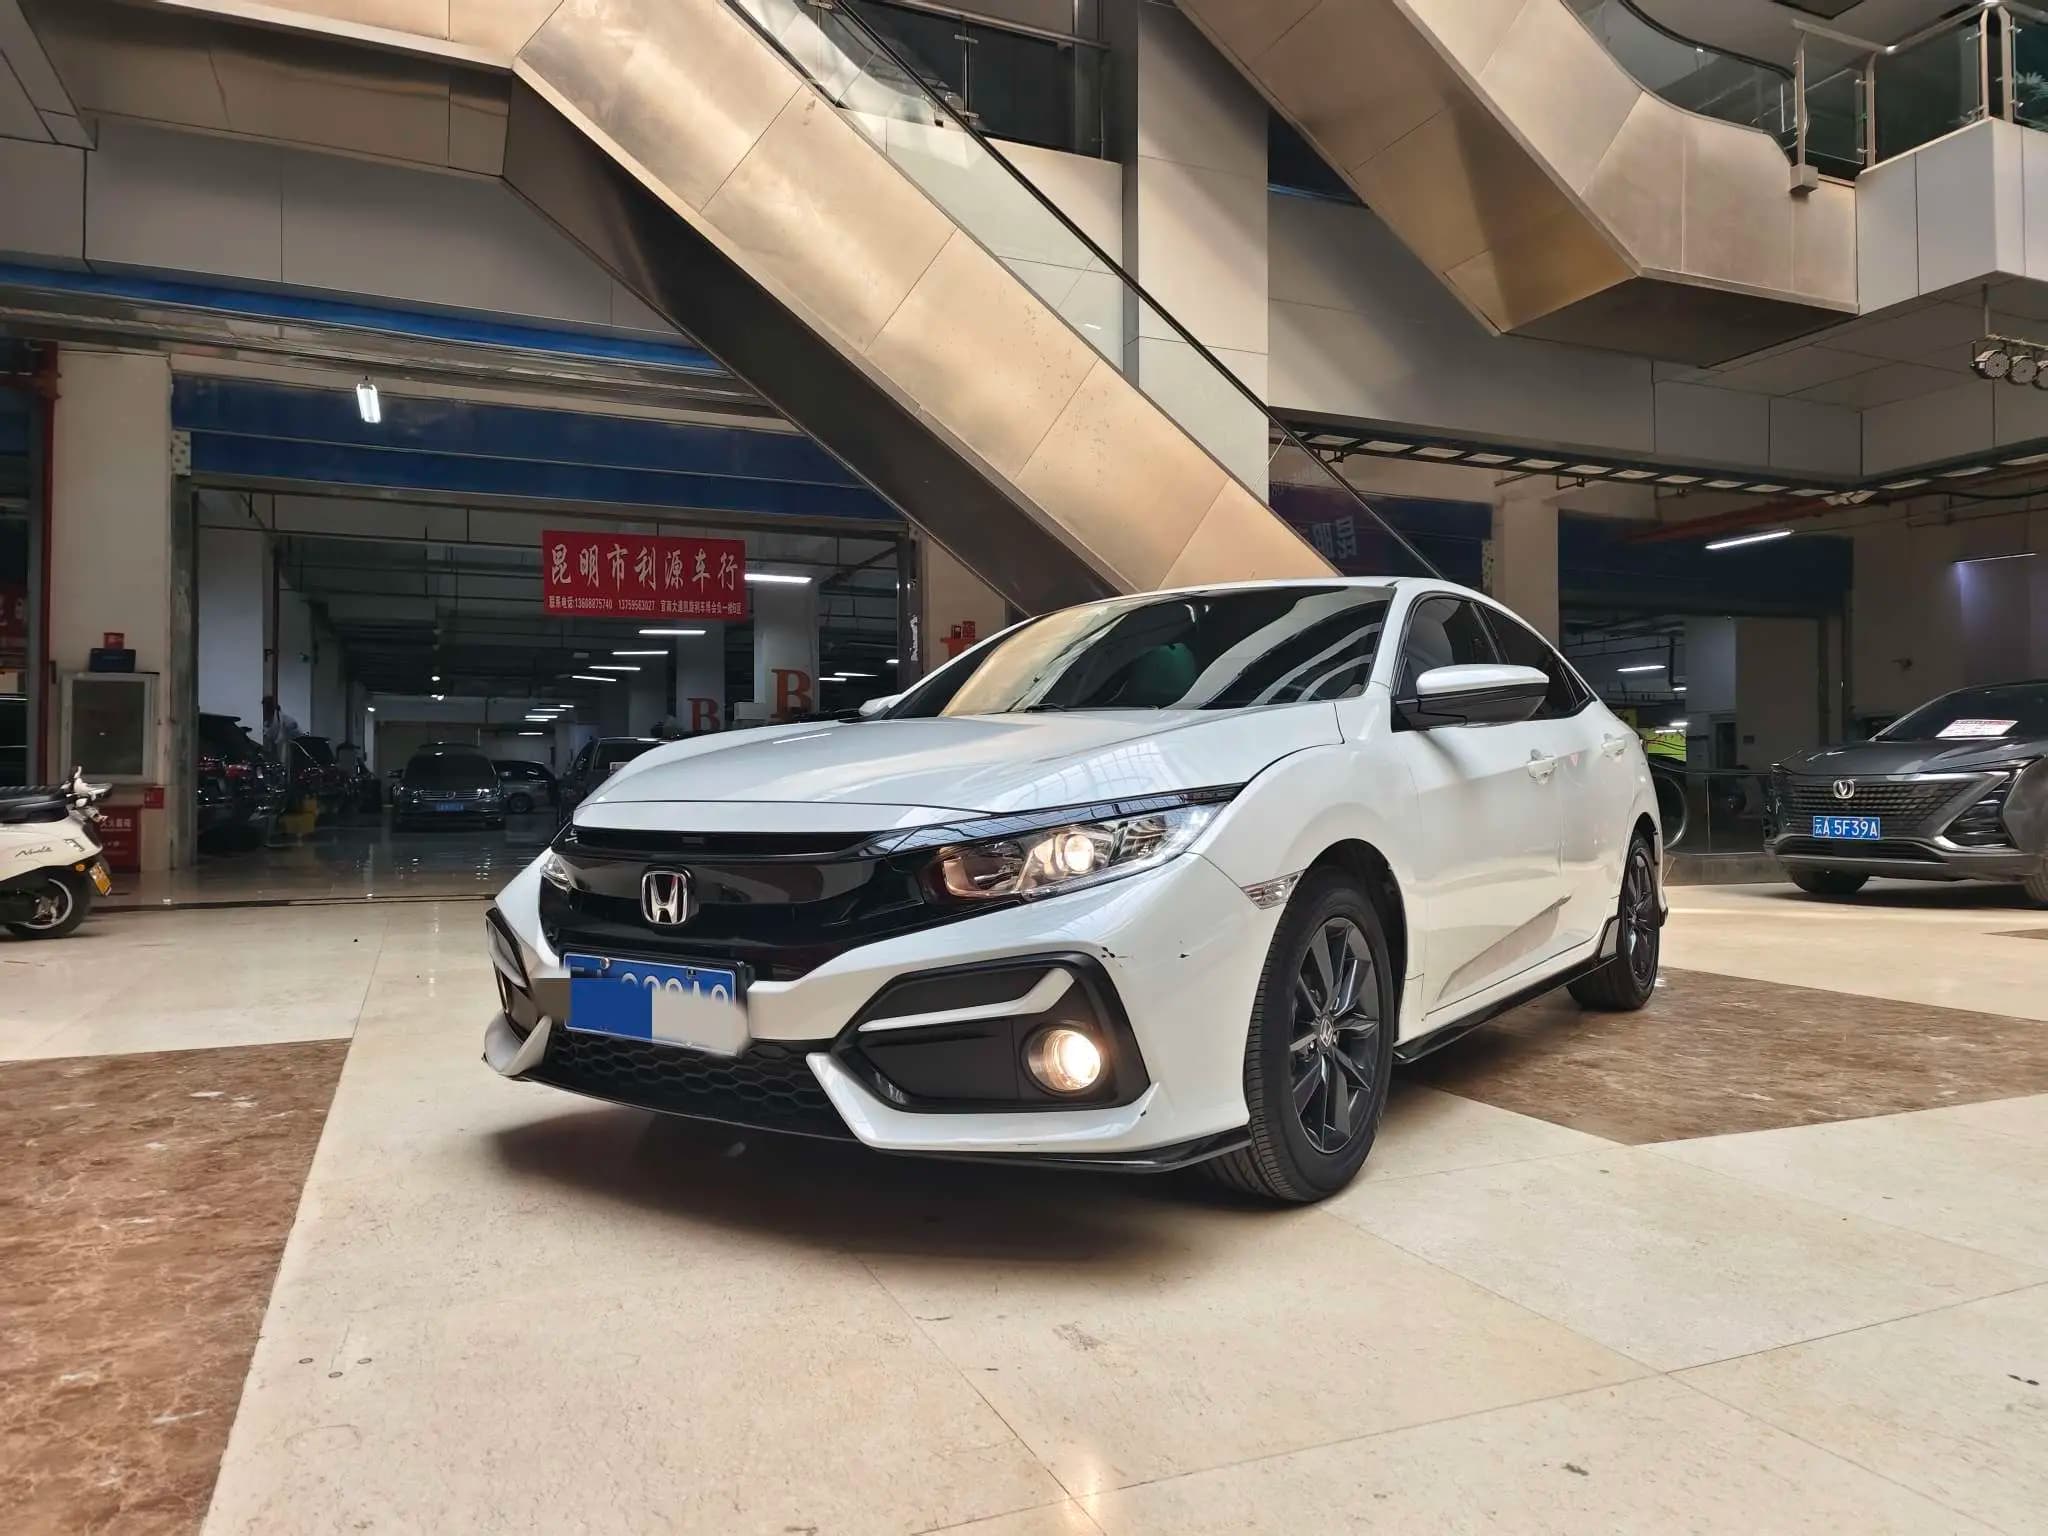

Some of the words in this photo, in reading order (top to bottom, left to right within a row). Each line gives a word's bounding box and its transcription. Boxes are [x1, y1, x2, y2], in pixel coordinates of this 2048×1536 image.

[551, 543, 739, 592] 昆明市利源车行
[771, 668, 812, 719] B
